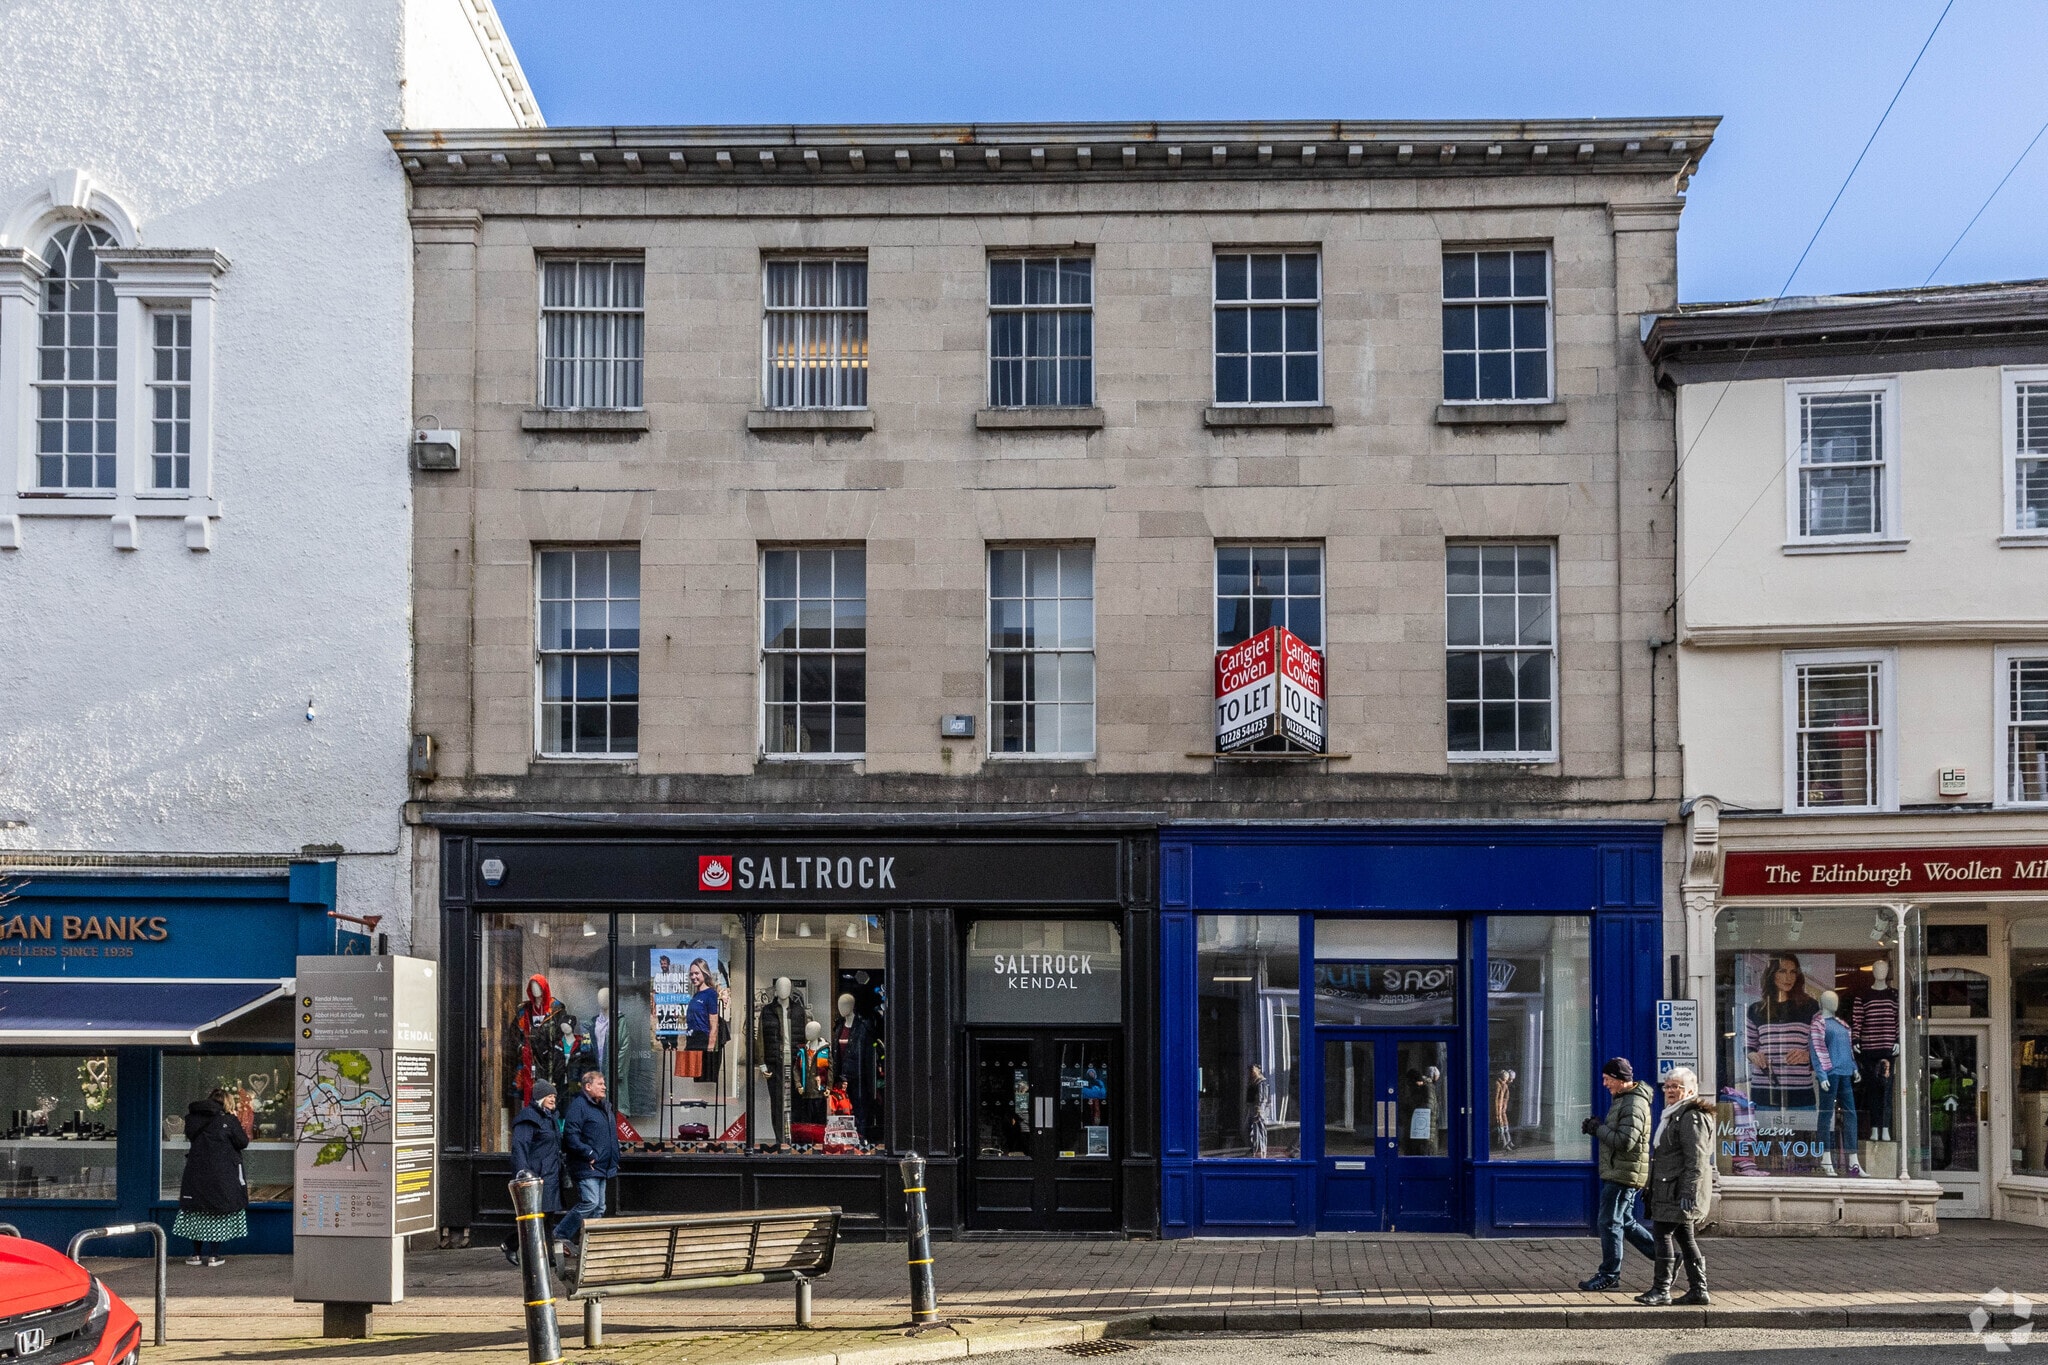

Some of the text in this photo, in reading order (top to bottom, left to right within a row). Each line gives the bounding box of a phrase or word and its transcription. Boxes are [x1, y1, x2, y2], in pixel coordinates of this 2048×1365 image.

[1220, 635, 1270, 674] Carigiet
[1284, 634, 1322, 676] Carigiet
[1222, 660, 1266, 692] Cowen
[1286, 657, 1320, 694] Cowen
[1218, 684, 1271, 726] TO LET
[1284, 684, 1323, 726] TO LET
[1220, 729, 1241, 746] 01228
[738, 856, 896, 889] SALTROCK
[1766, 865, 1800, 884] The
[1810, 863, 1912, 886] Edinburgh
[1924, 861, 2002, 880] Woollen
[62, 916, 168, 941] BANKS
[61, 946, 98, 958] SINCE
[104, 946, 134, 958] 1935
[994, 954, 1092, 974] SALTROCK
[672, 972, 688, 982] ONE
[1008, 977, 1078, 988] KENDAL
[656, 984, 688, 993] GET ONE
[656, 1004, 688, 1016] EVERY
[1662, 1004, 1670, 1014] P
[398, 1030, 434, 1042] KENDAL
[620, 1122, 634, 1138] SALE
[728, 1122, 742, 1138] SALE
[1717, 1120, 1796, 1138] New Season
[1722, 1141, 1825, 1158] NEW YOU
